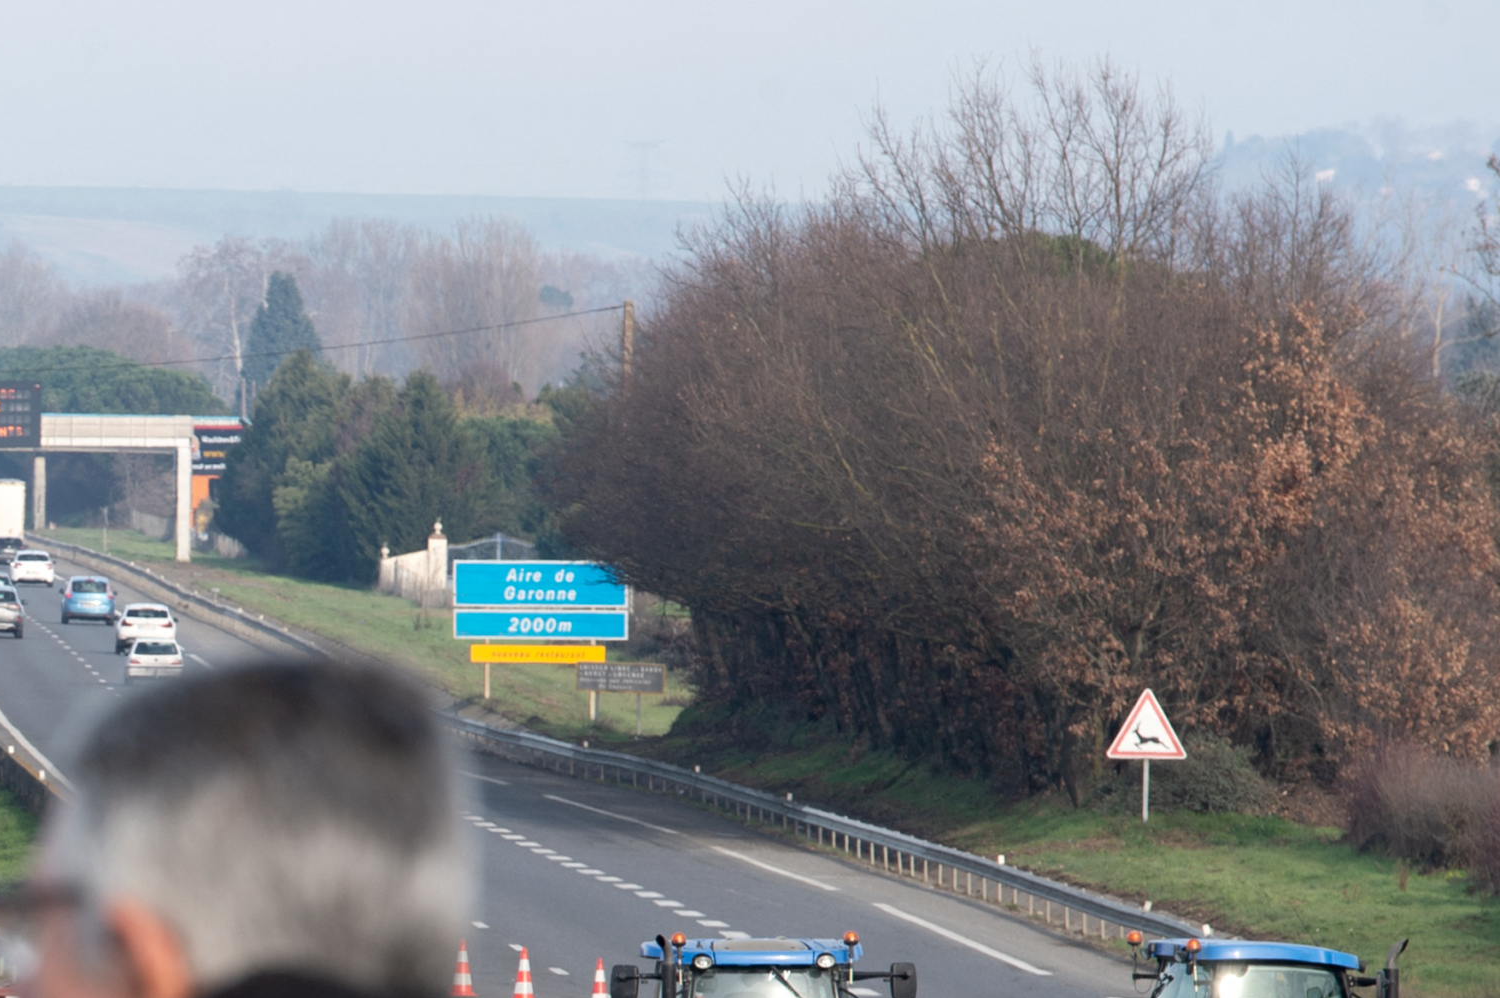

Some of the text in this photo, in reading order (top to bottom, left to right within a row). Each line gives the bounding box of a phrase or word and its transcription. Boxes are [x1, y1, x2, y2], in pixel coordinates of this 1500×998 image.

[505, 567, 575, 583] Aire de
[503, 585, 577, 601] Garonne
[507, 616, 572, 633] 2000m
